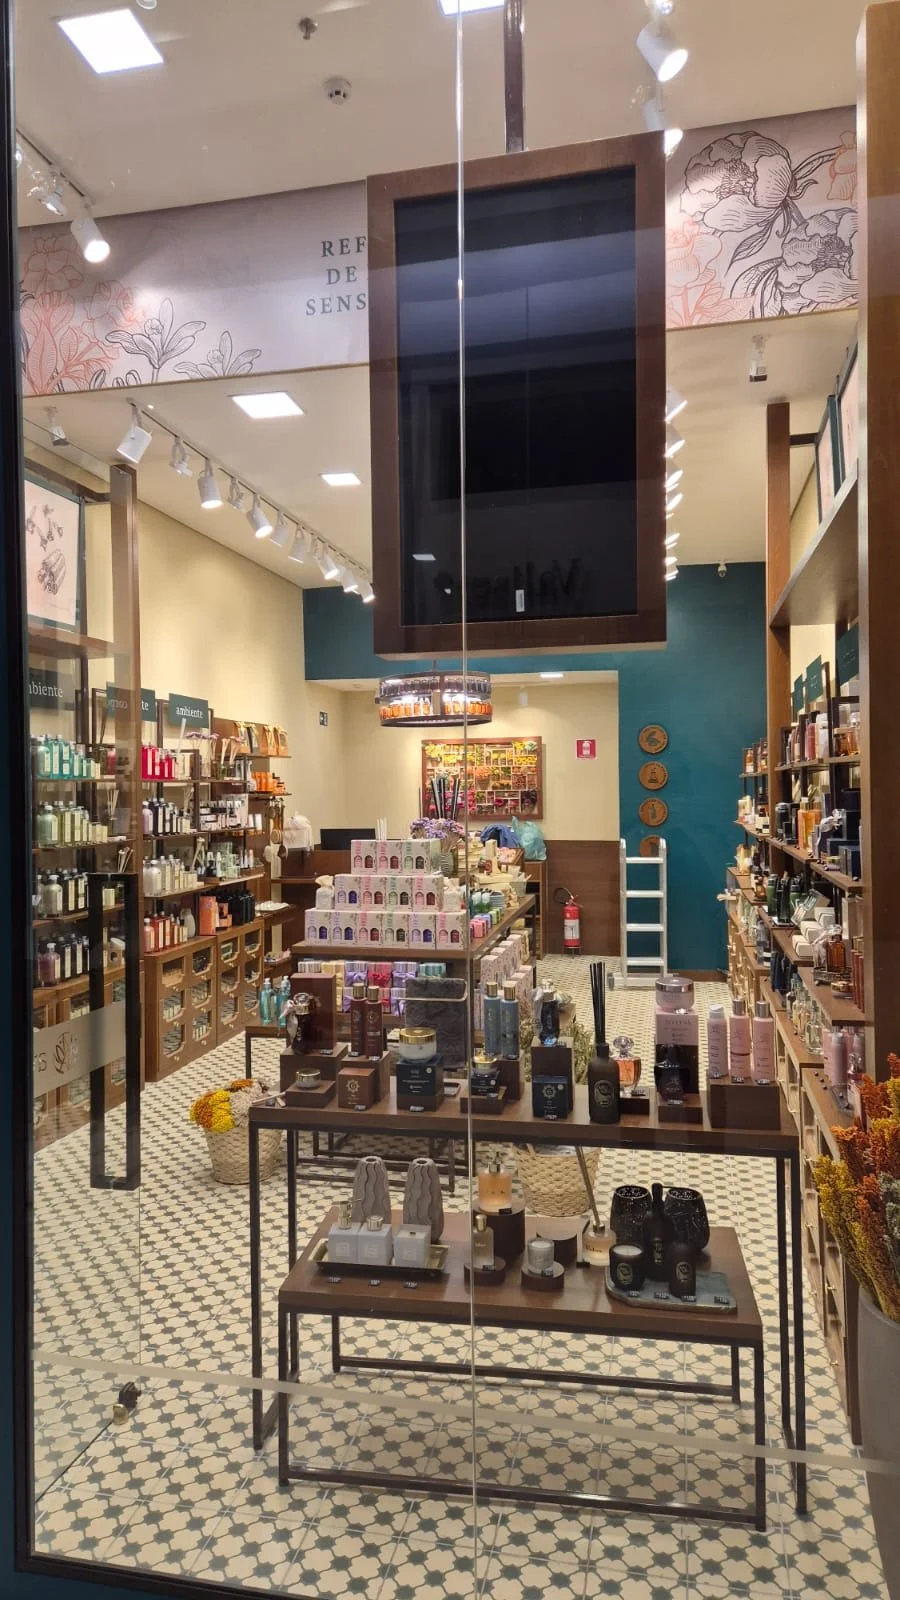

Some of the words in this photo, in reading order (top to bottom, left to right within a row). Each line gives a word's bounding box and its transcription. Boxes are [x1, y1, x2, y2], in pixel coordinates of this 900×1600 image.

[321, 236, 366, 257] REF
[326, 266, 357, 285] DE
[305, 293, 366, 316] SENS
[175, 705, 203, 719] ambiente
